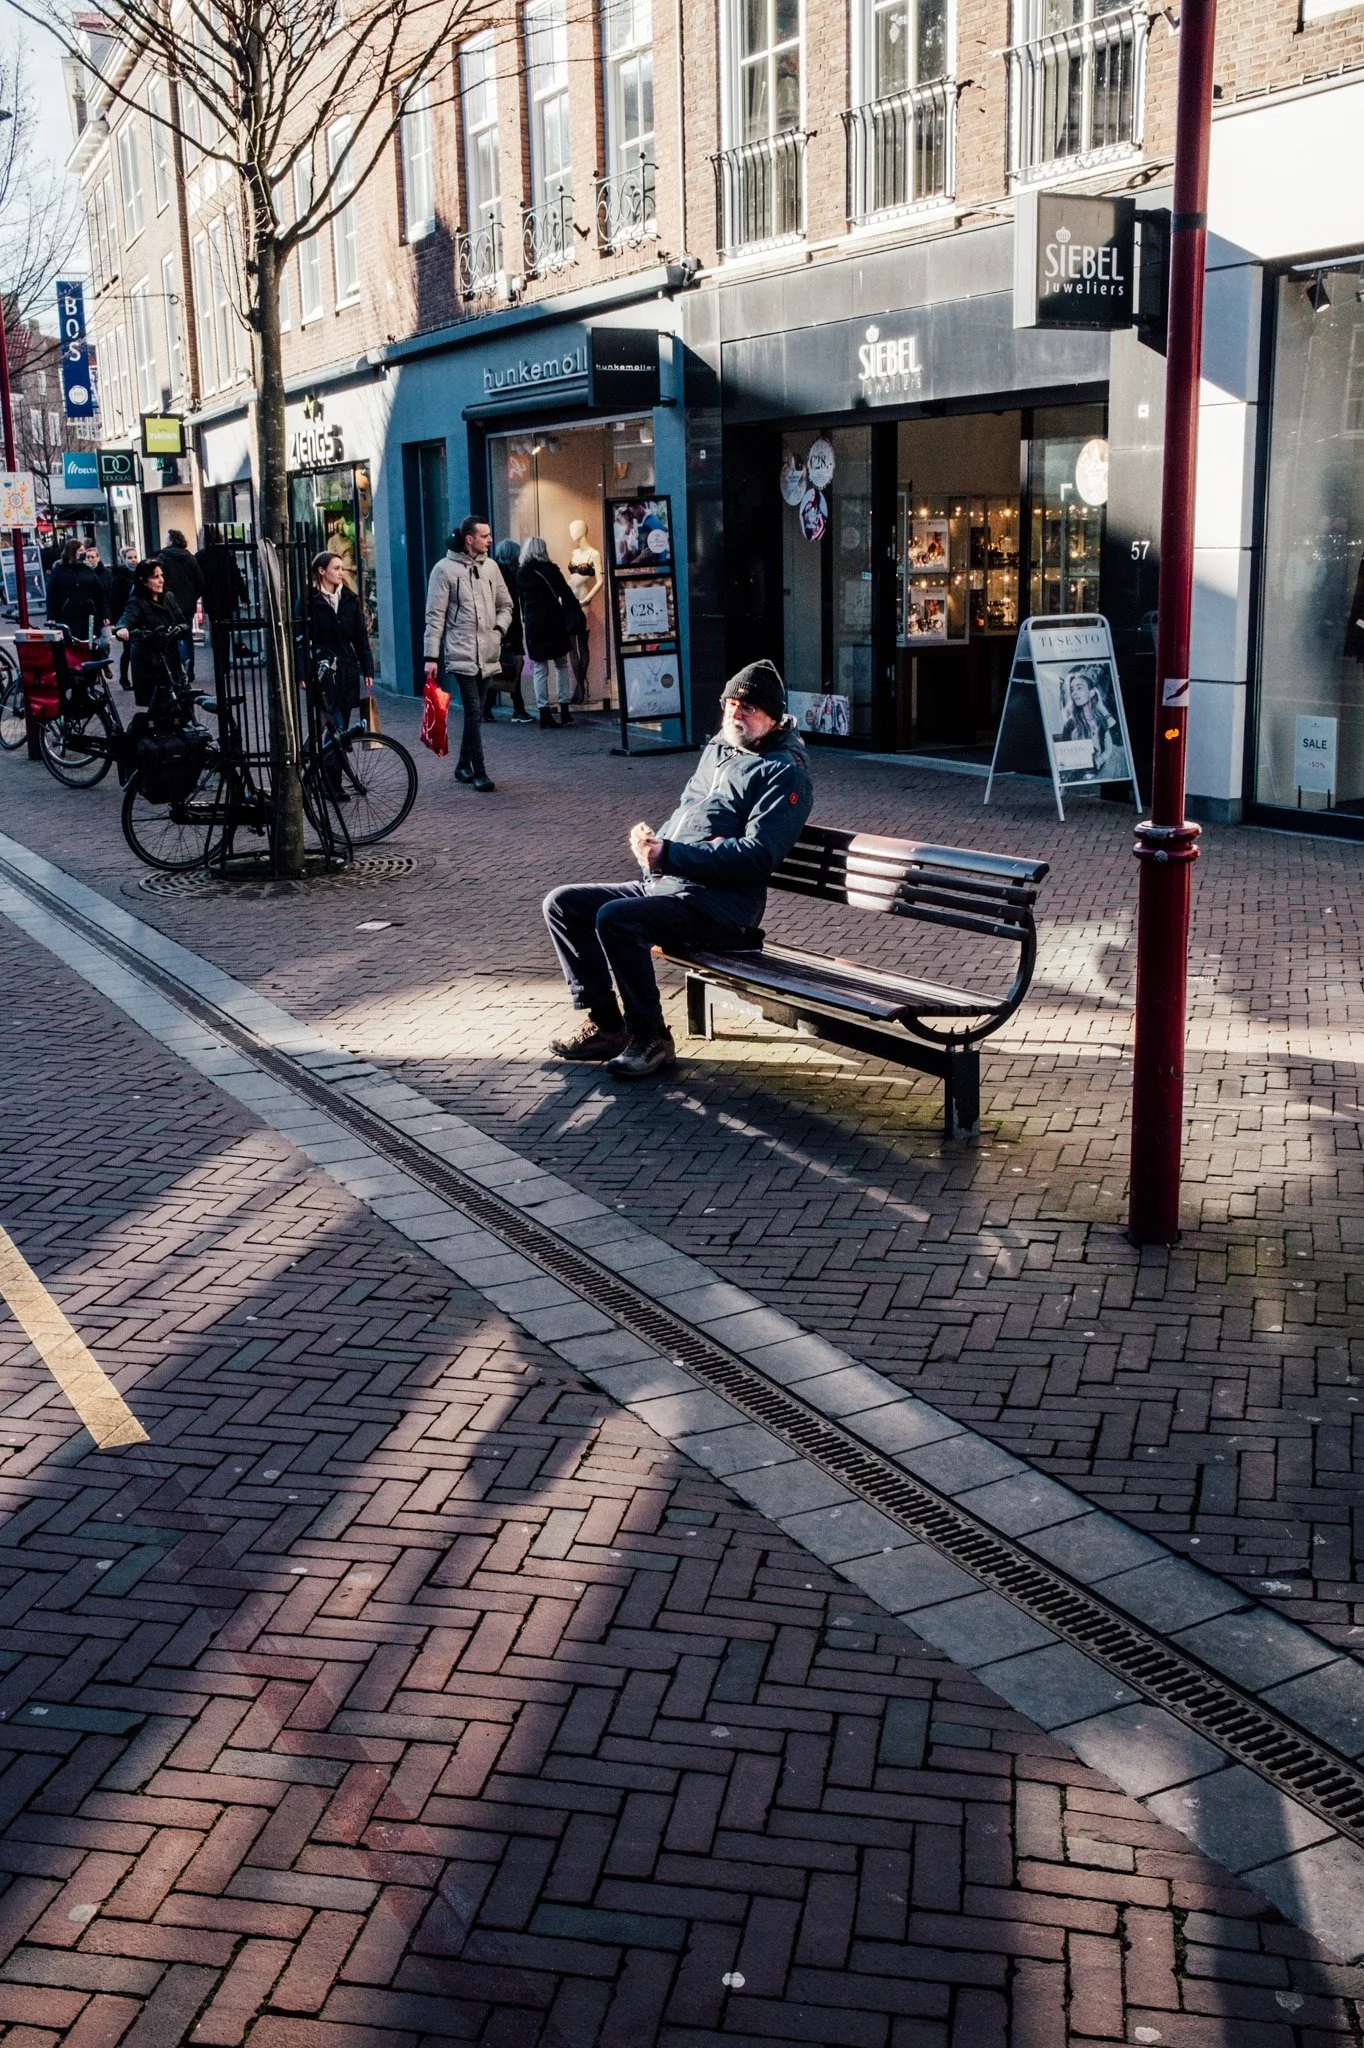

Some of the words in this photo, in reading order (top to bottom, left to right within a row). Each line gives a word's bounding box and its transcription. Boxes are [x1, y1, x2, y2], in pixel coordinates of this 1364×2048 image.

[1044, 243, 1124, 281] SIEBEL
[64, 296, 82, 361] BOS
[858, 336, 923, 381] SIEBEL
[78, 467, 97, 475] DELTA
[1130, 540, 1150, 560] 57
[1056, 633, 1100, 646] SENTO
[1302, 738, 1328, 750] SALE
[1308, 761, 1326, 769] -50%
